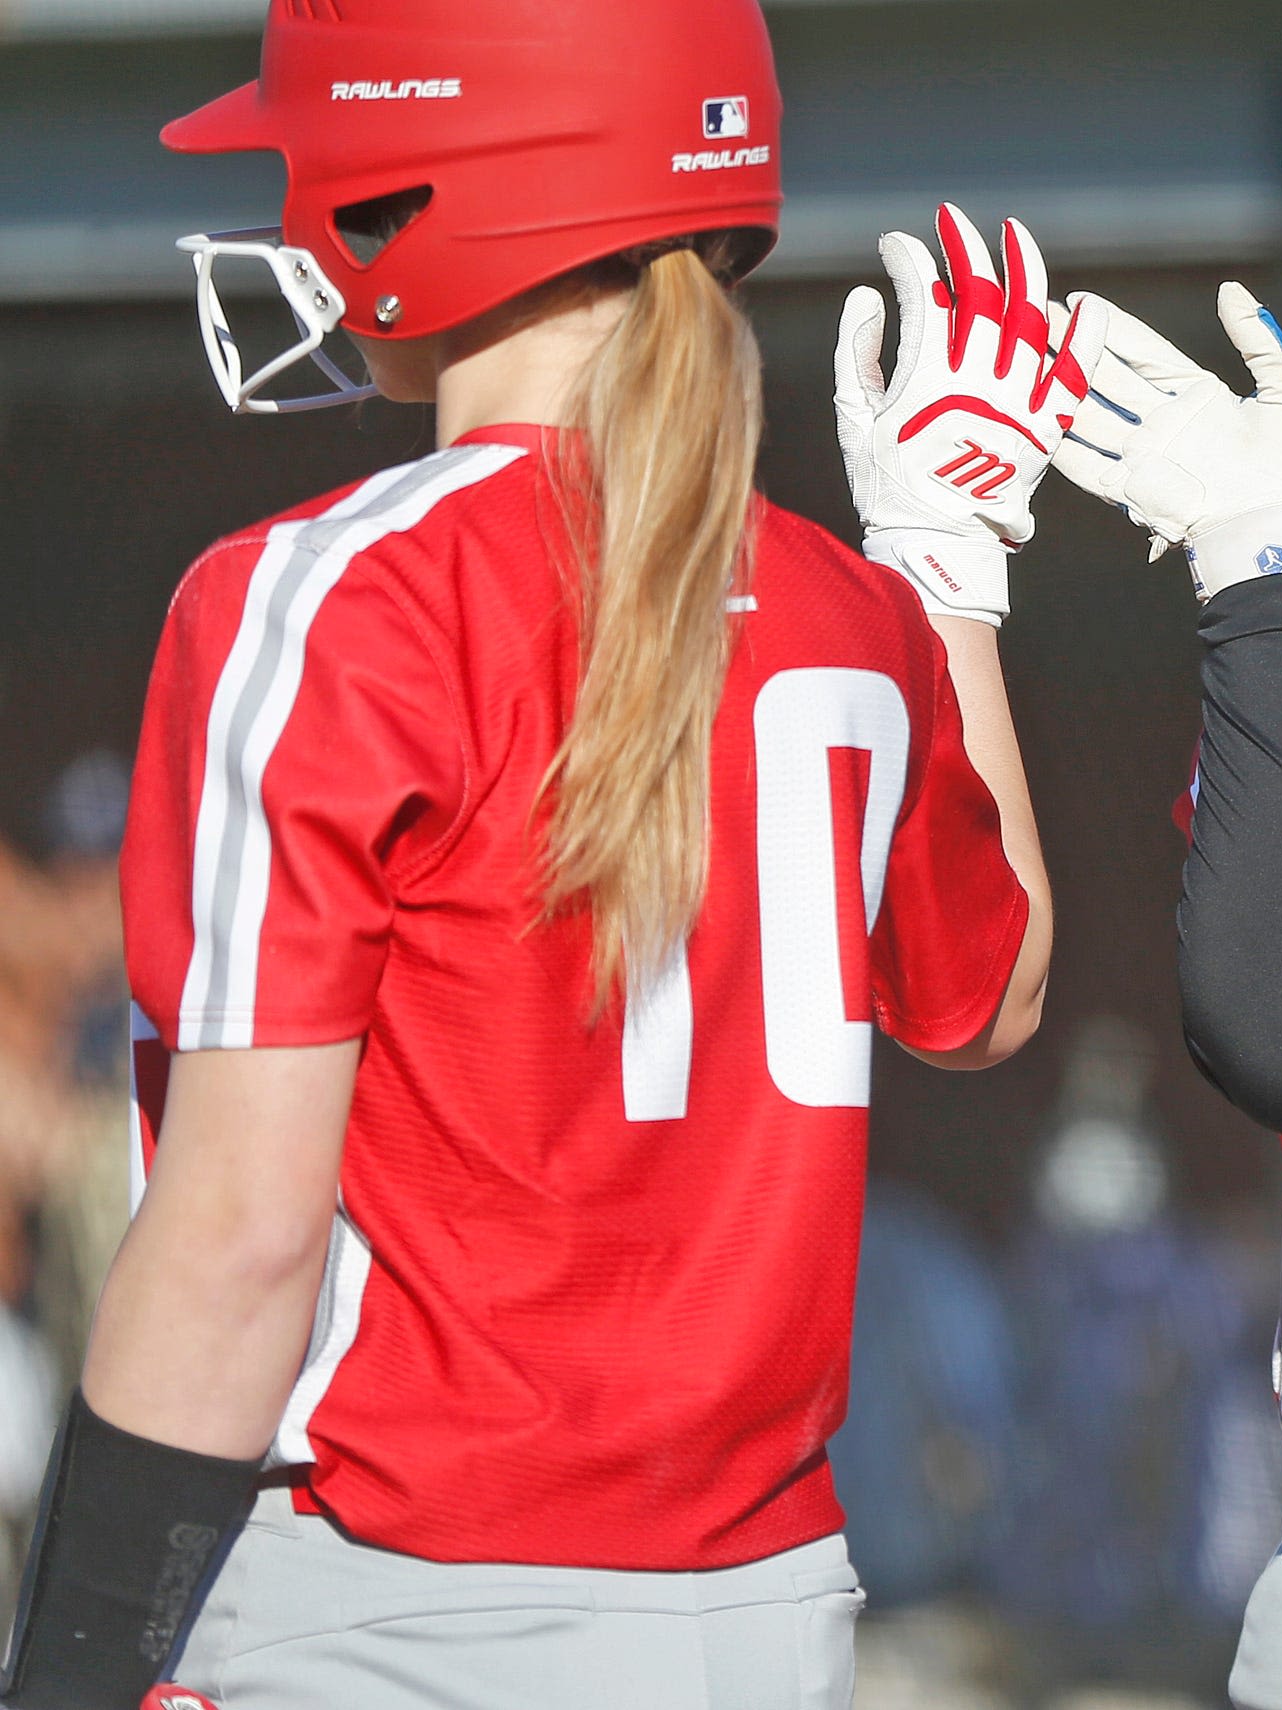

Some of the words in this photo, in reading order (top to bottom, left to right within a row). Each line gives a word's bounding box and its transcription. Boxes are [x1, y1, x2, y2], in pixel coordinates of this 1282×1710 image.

[331, 78, 462, 101] RAWLINGS
[671, 145, 770, 173] RAWLINGS
[923, 554, 963, 593] marucci
